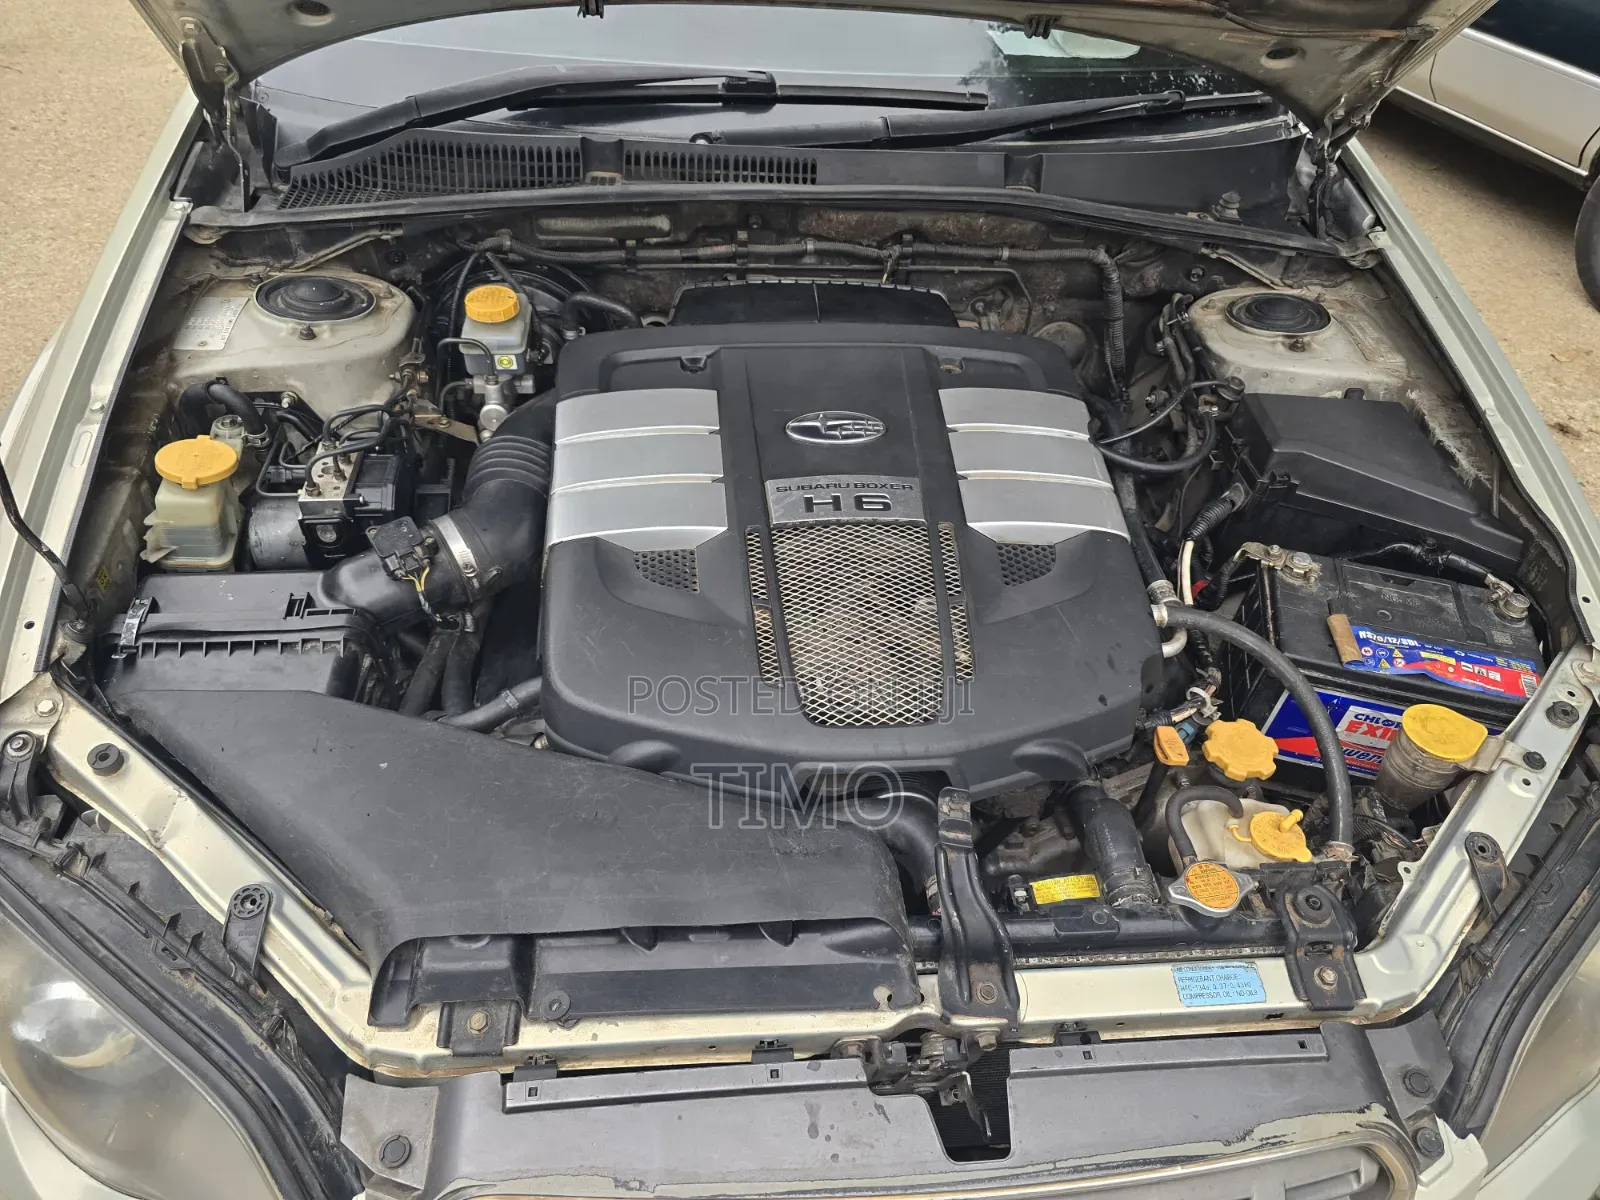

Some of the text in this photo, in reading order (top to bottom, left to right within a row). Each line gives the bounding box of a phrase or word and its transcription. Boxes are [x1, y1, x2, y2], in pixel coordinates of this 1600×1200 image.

[775, 482, 915, 493] SUBARU BOXER
[1177, 974, 1215, 984] REFRIGERANT
[1182, 992, 1221, 1001] COMPRESSOR
